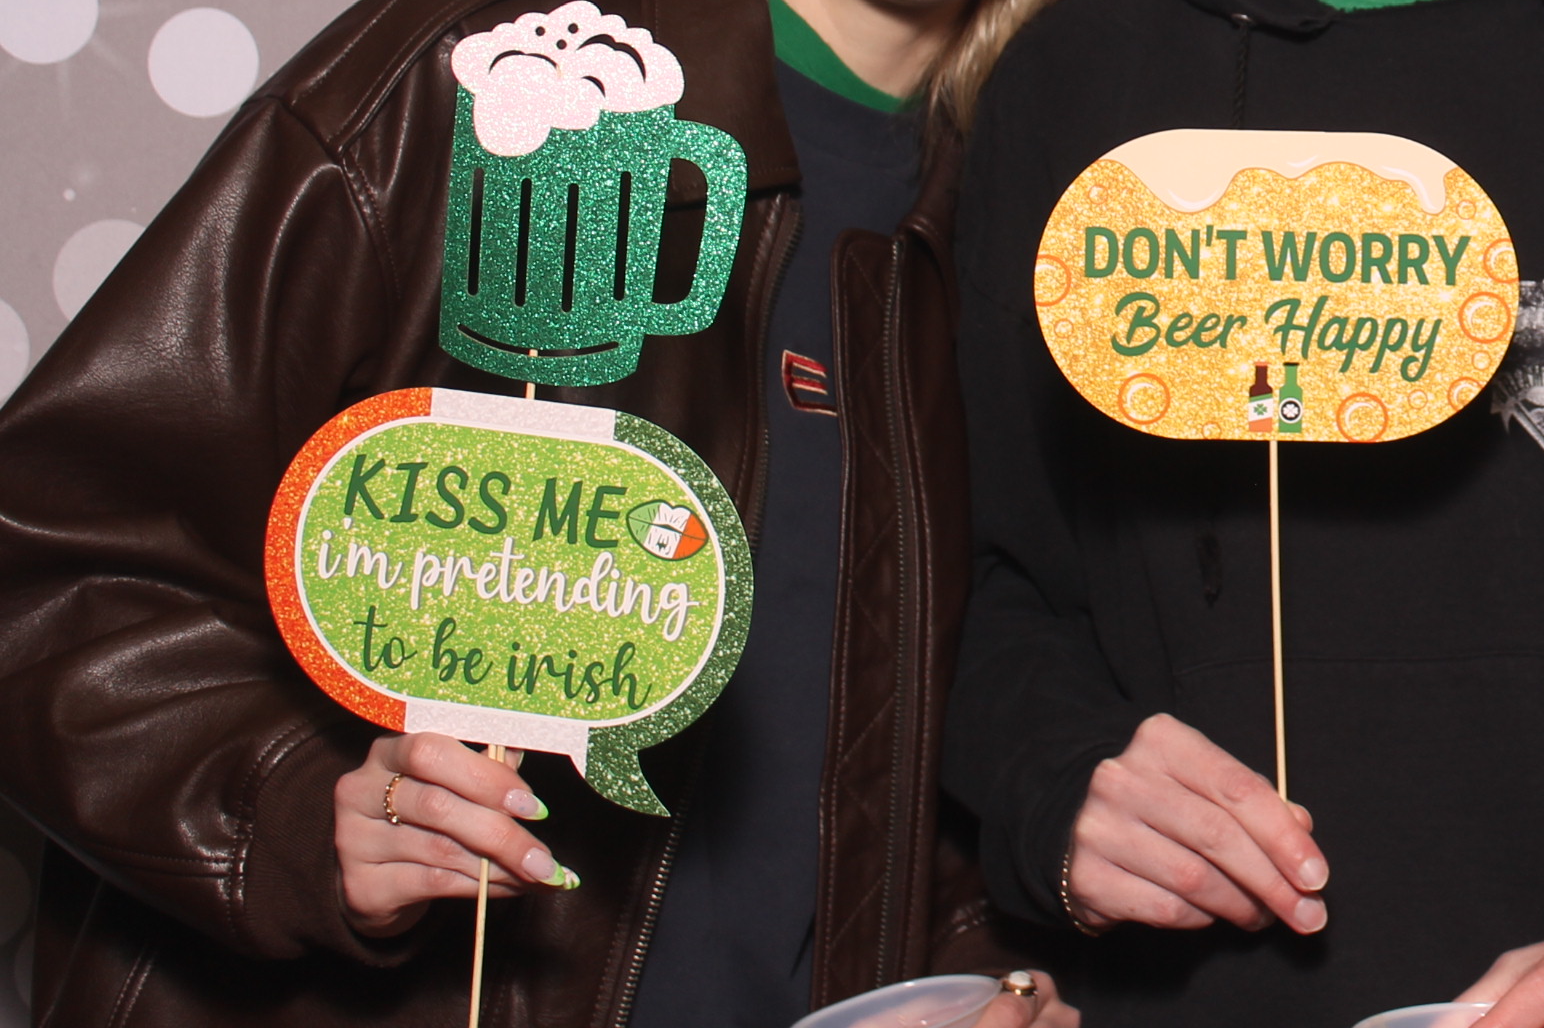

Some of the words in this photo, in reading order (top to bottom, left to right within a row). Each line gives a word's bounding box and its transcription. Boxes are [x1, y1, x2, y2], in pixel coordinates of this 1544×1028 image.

[1083, 224, 1247, 280] DON'T
[1262, 231, 1471, 286] WORRY
[1110, 292, 1247, 357] Beer
[1263, 296, 1441, 382] Happy
[343, 454, 511, 535] KISS
[532, 477, 629, 548] ME
[410, 535, 699, 642] pretending
[354, 606, 417, 671] to
[432, 618, 494, 682] be
[506, 642, 651, 710] irish
